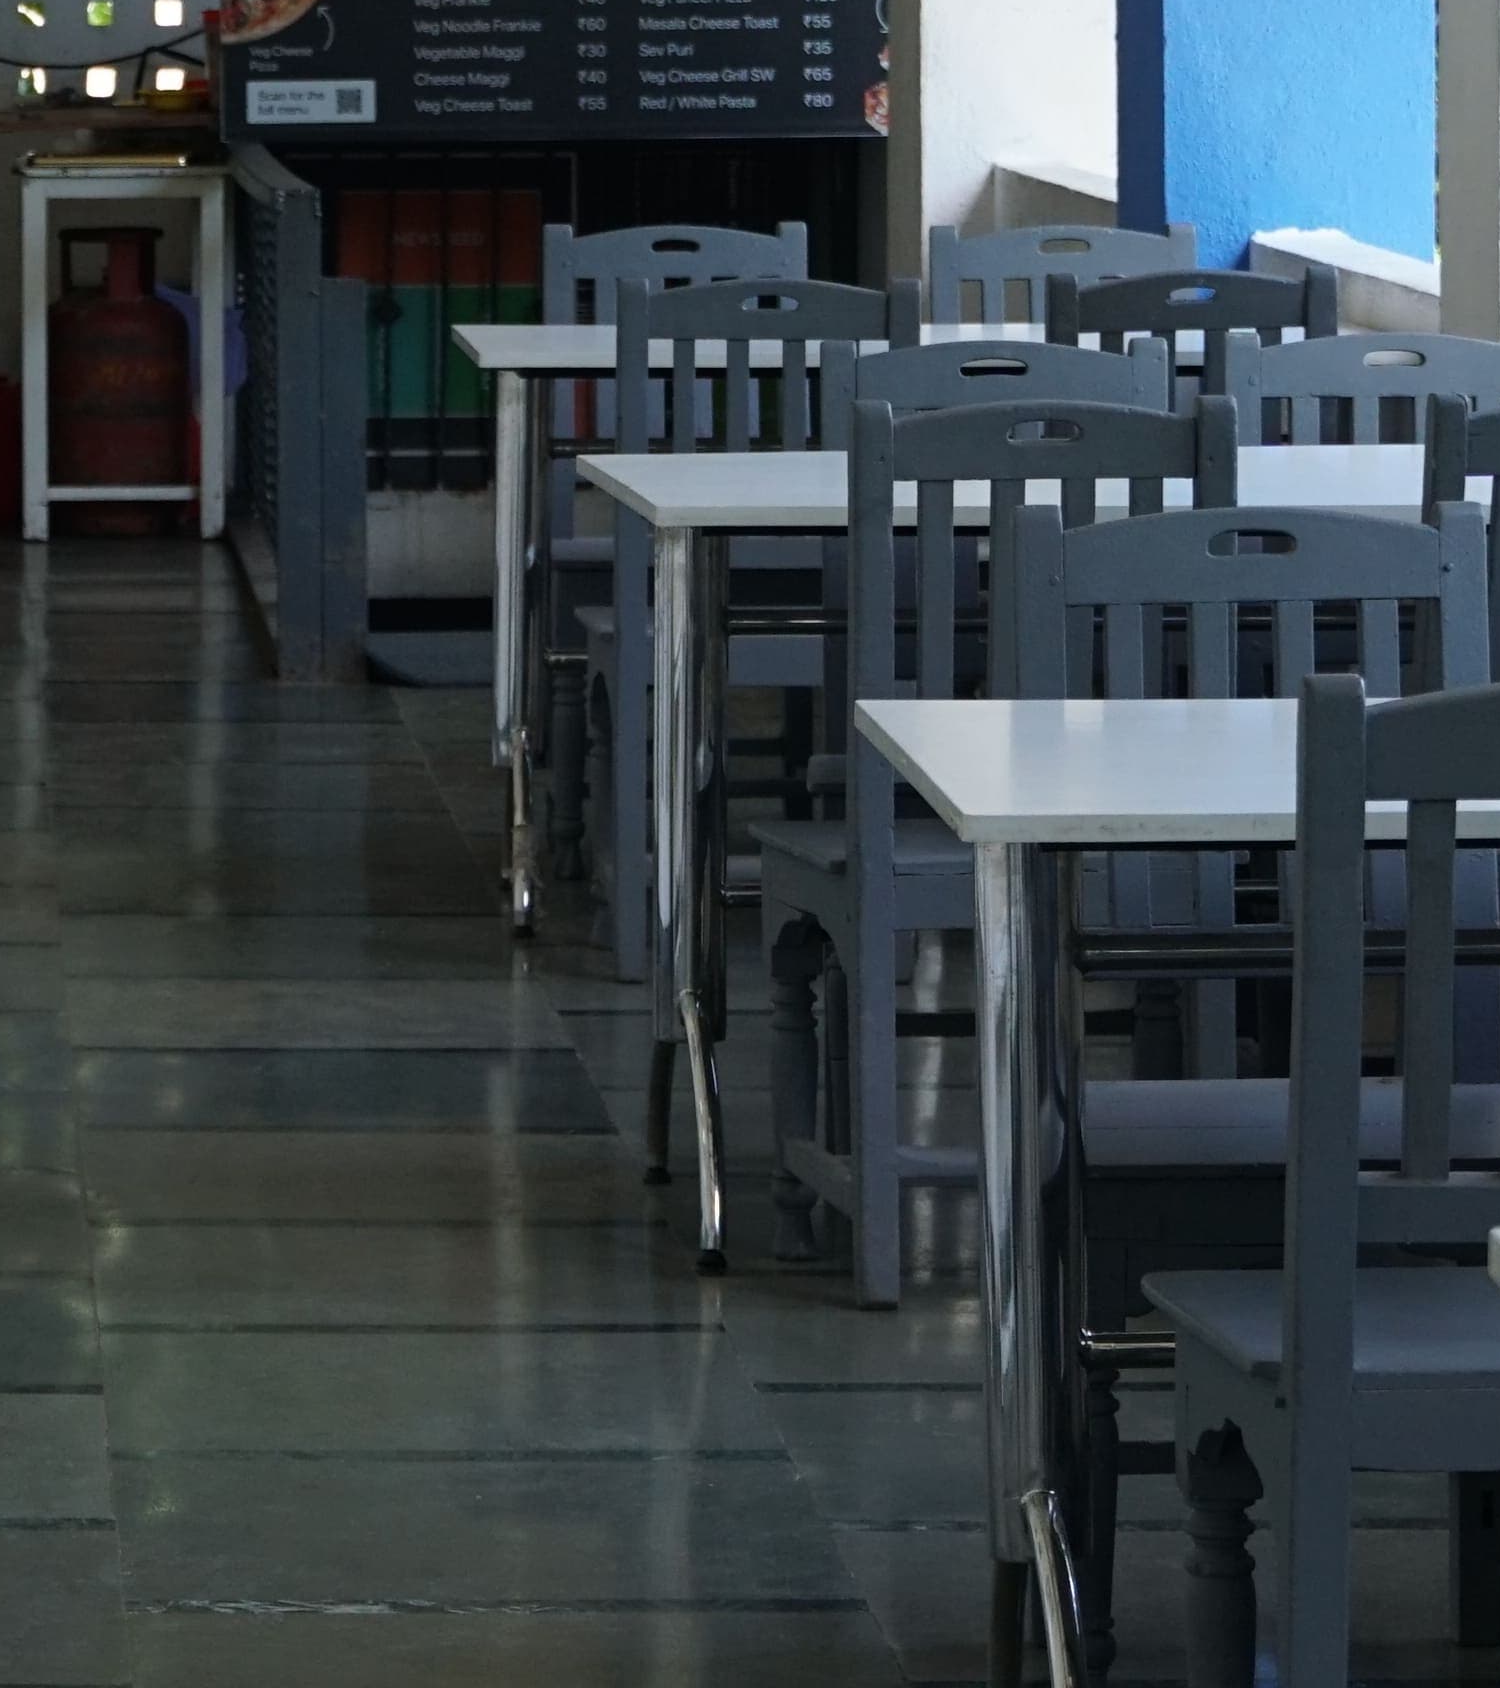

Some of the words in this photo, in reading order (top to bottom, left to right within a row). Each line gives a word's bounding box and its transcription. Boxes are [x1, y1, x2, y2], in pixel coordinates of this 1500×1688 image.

[413, 20, 440, 36] Veg
[442, 19, 491, 33] Noodle
[493, 18, 543, 32] Frankie
[639, 17, 687, 31] Masala
[689, 15, 741, 30] Cheese
[744, 15, 780, 29] Toast
[803, 15, 833, 29] ₹55
[414, 46, 481, 62] Vegetable
[483, 45, 527, 62] Maggi
[639, 43, 666, 57] Sev
[668, 43, 694, 56] Puri
[803, 41, 833, 55] ₹35
[413, 72, 466, 87] Cheese
[467, 72, 511, 88] Maggi
[639, 71, 666, 86] Veg
[668, 68, 719, 83] Cheese
[722, 68, 748, 82] Grill
[751, 68, 776, 82] SW
[803, 67, 833, 81] ₹65
[257, 90, 286, 101] Scan
[639, 96, 667, 109] Red
[678, 95, 717, 109] White
[719, 95, 758, 108] Pasta
[414, 99, 441, 115] Veg
[443, 98, 495, 112] Cheese
[497, 98, 534, 112] Toast
